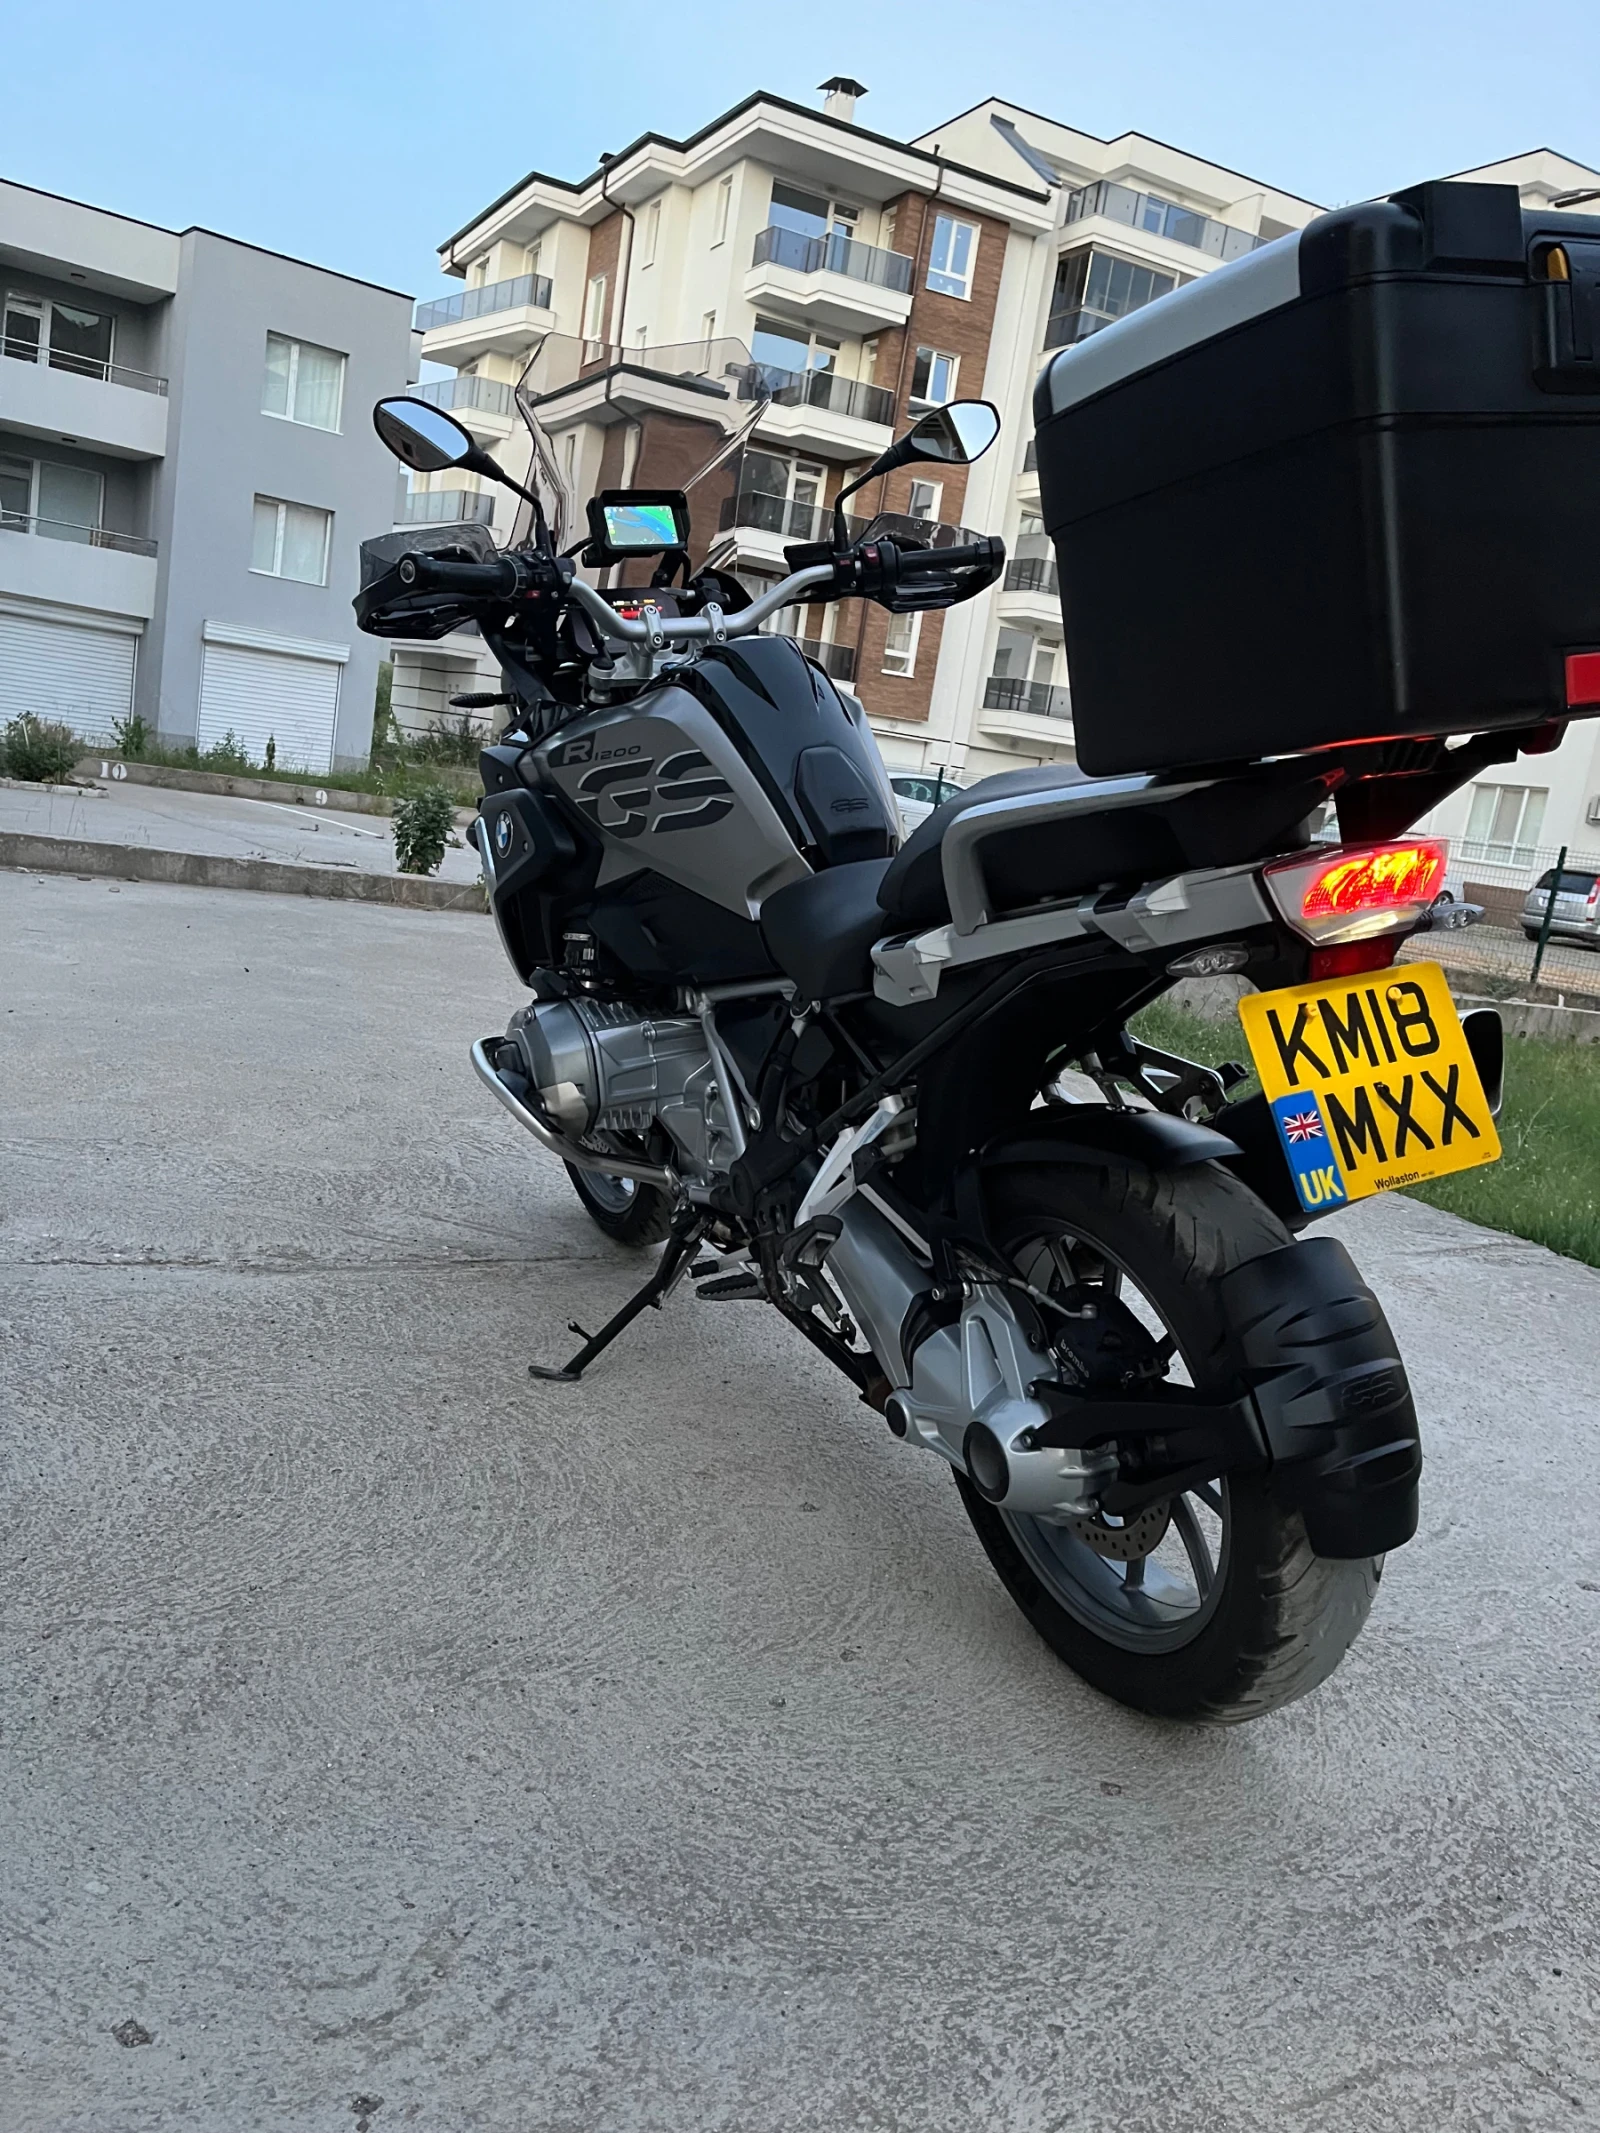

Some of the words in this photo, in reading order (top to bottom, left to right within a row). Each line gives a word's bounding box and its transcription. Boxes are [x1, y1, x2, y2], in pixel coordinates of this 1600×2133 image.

[100, 761, 128, 780] 10
[563, 740, 592, 764] R
[594, 745, 641, 761] 1200
[575, 749, 735, 839] GS
[1266, 981, 1440, 1086] KM18
[1324, 1064, 1481, 1172] MXX
[1299, 1165, 1344, 1204] UK
[1374, 1171, 1419, 1190] Wollaston
[1060, 1339, 1090, 1378] brembo
